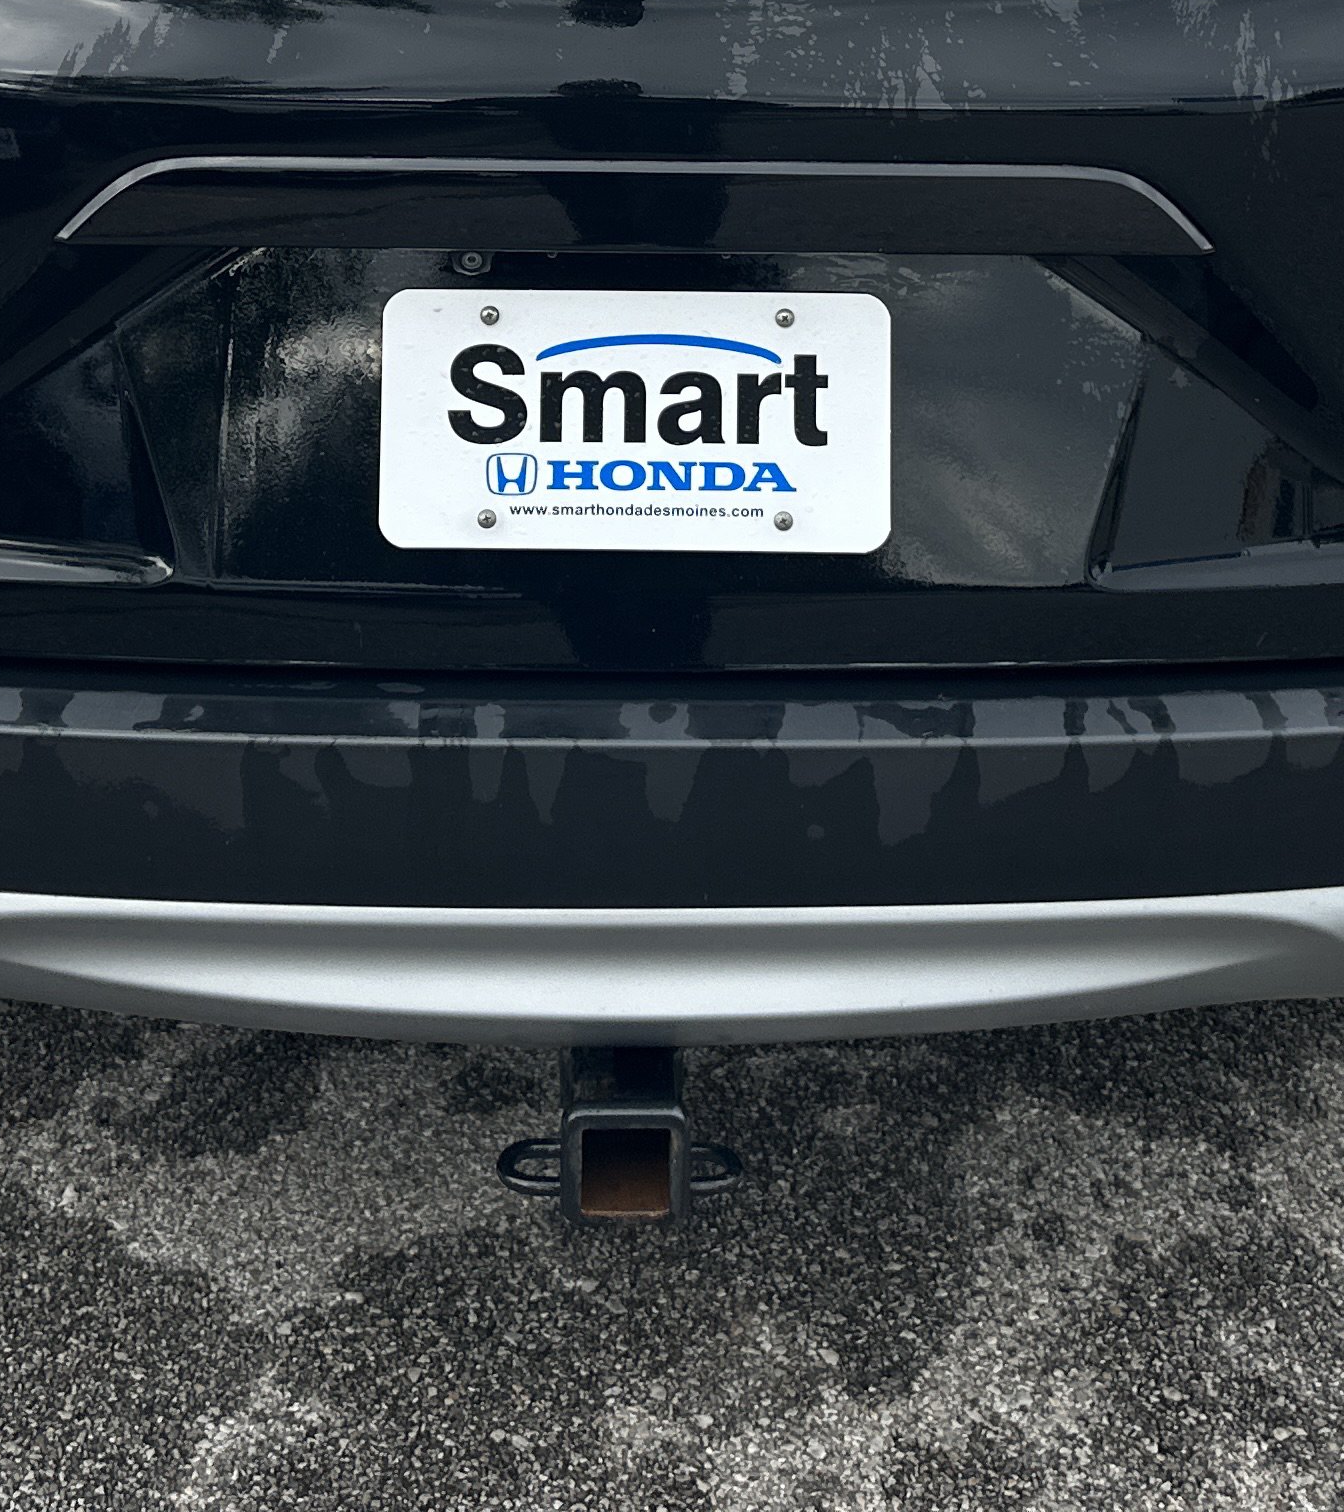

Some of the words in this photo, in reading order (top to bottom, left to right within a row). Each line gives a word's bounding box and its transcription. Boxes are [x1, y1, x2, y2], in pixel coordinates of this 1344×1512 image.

[447, 342, 829, 447] Smart
[547, 459, 797, 492] HONDA
[509, 503, 765, 520] www.smarthondadesmoines.com
